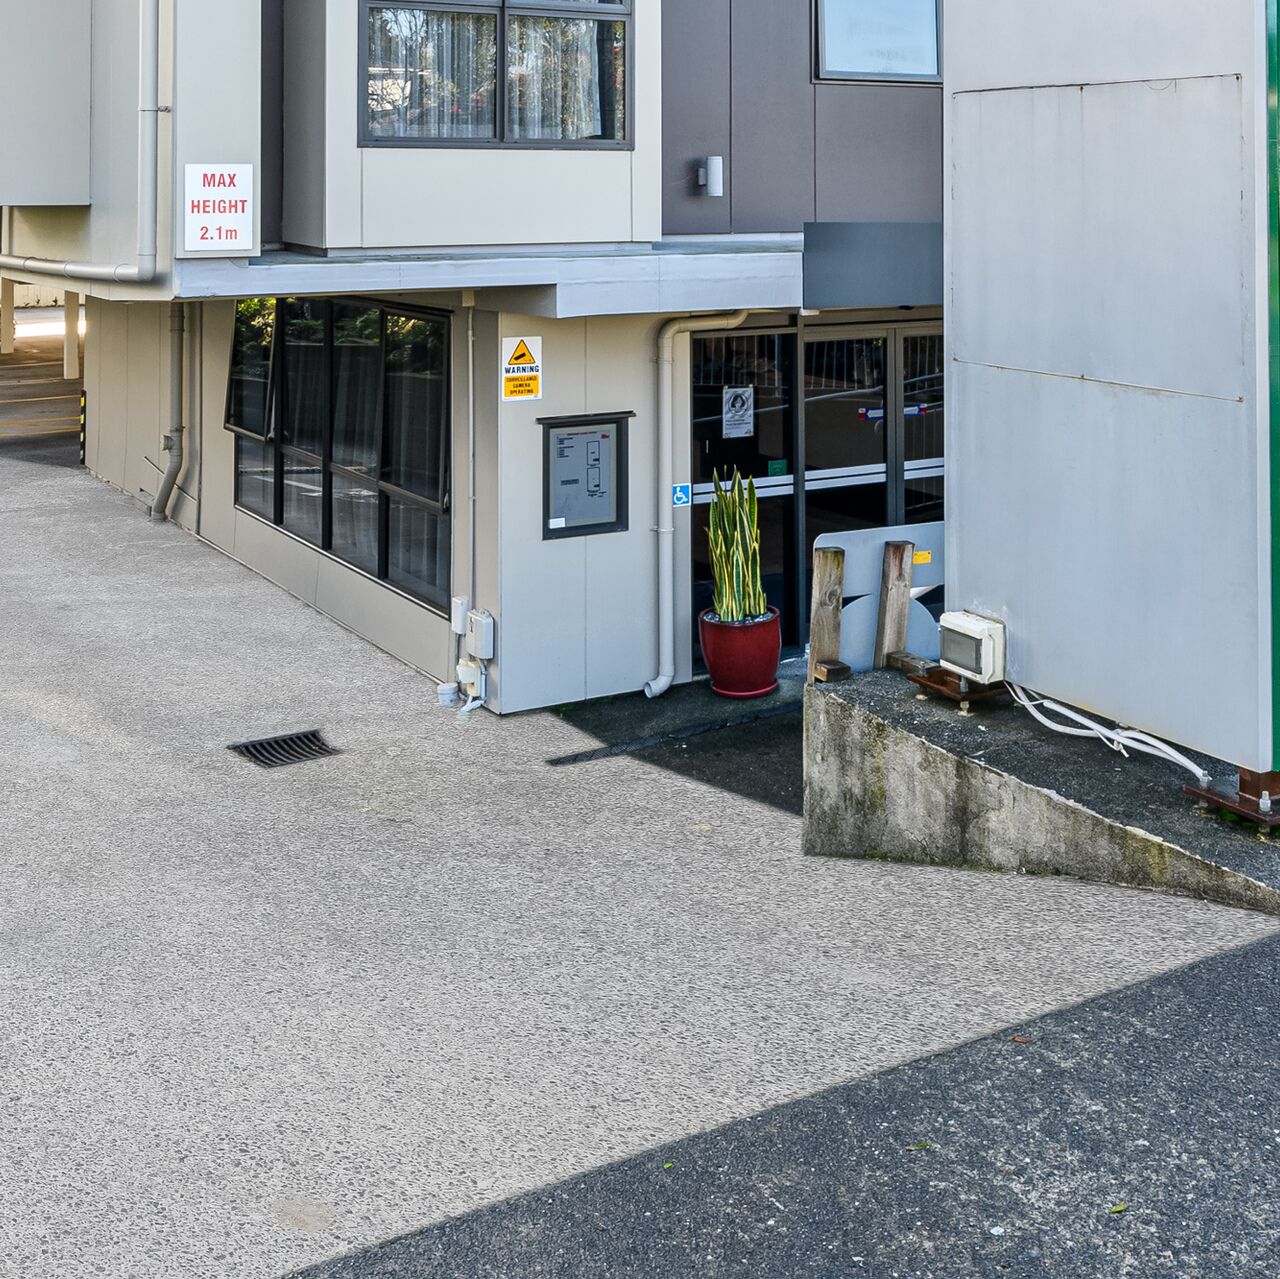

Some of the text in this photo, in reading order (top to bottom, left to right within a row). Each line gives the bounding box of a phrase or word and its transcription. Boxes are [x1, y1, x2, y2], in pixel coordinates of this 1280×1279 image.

[202, 173, 236, 187] MAX
[191, 199, 248, 214] HEIGHT
[200, 226, 238, 240] 2.1m
[504, 365, 540, 374] WARNING
